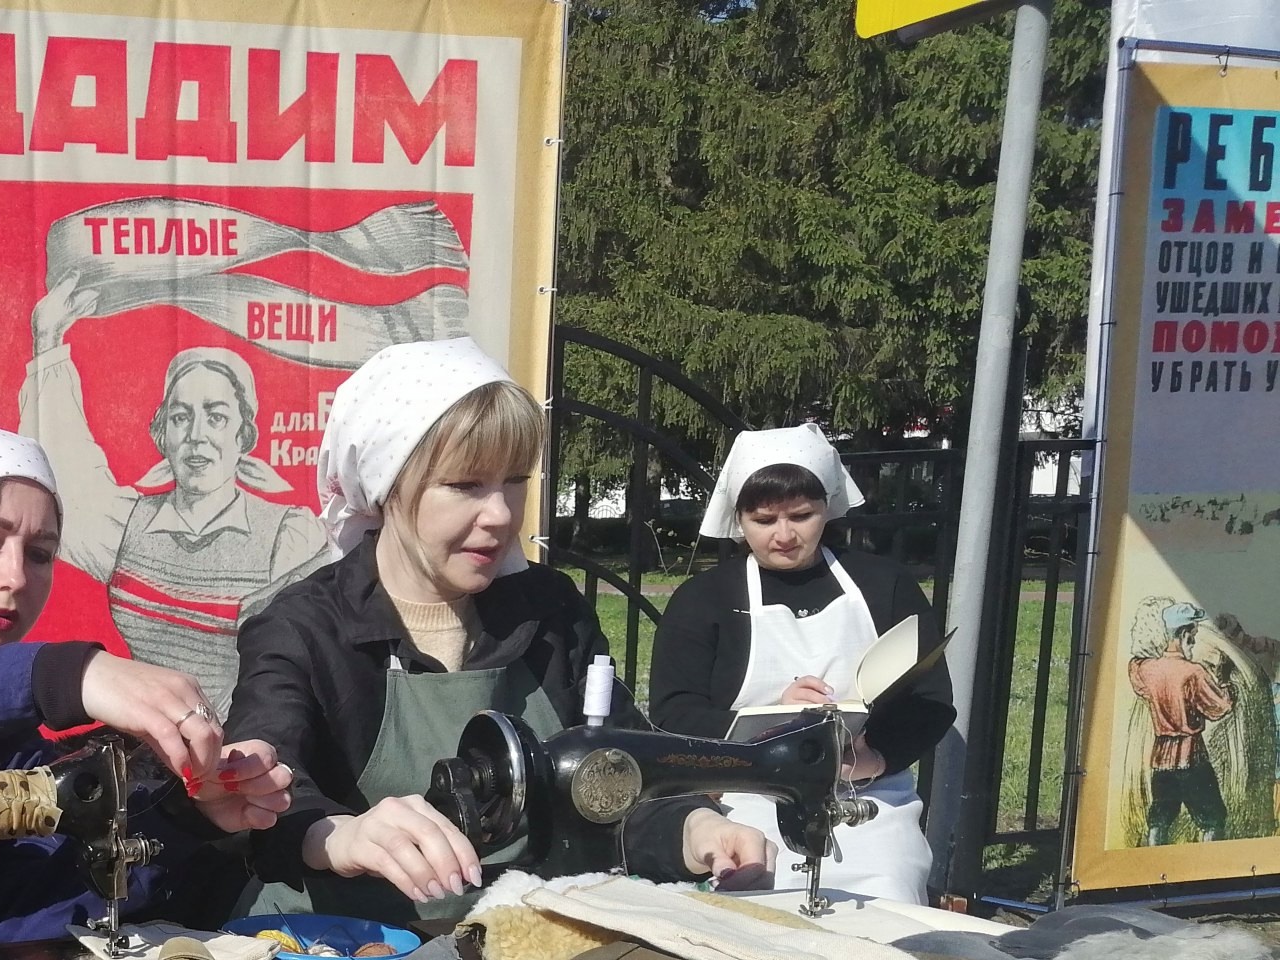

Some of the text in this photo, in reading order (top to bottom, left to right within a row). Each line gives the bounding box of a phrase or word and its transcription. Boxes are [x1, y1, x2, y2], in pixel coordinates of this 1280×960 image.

[1163, 111, 1277, 191] РЕБ
[83, 216, 238, 257] ТЕПЛЫЕ
[1158, 240, 1234, 277] ОТЦОВ
[1247, 241, 1265, 274] И
[1156, 281, 1273, 317] УШЕДШИХ
[247, 302, 337, 345] ВЕЩИ
[1151, 360, 1251, 393] УБРАТЬ
